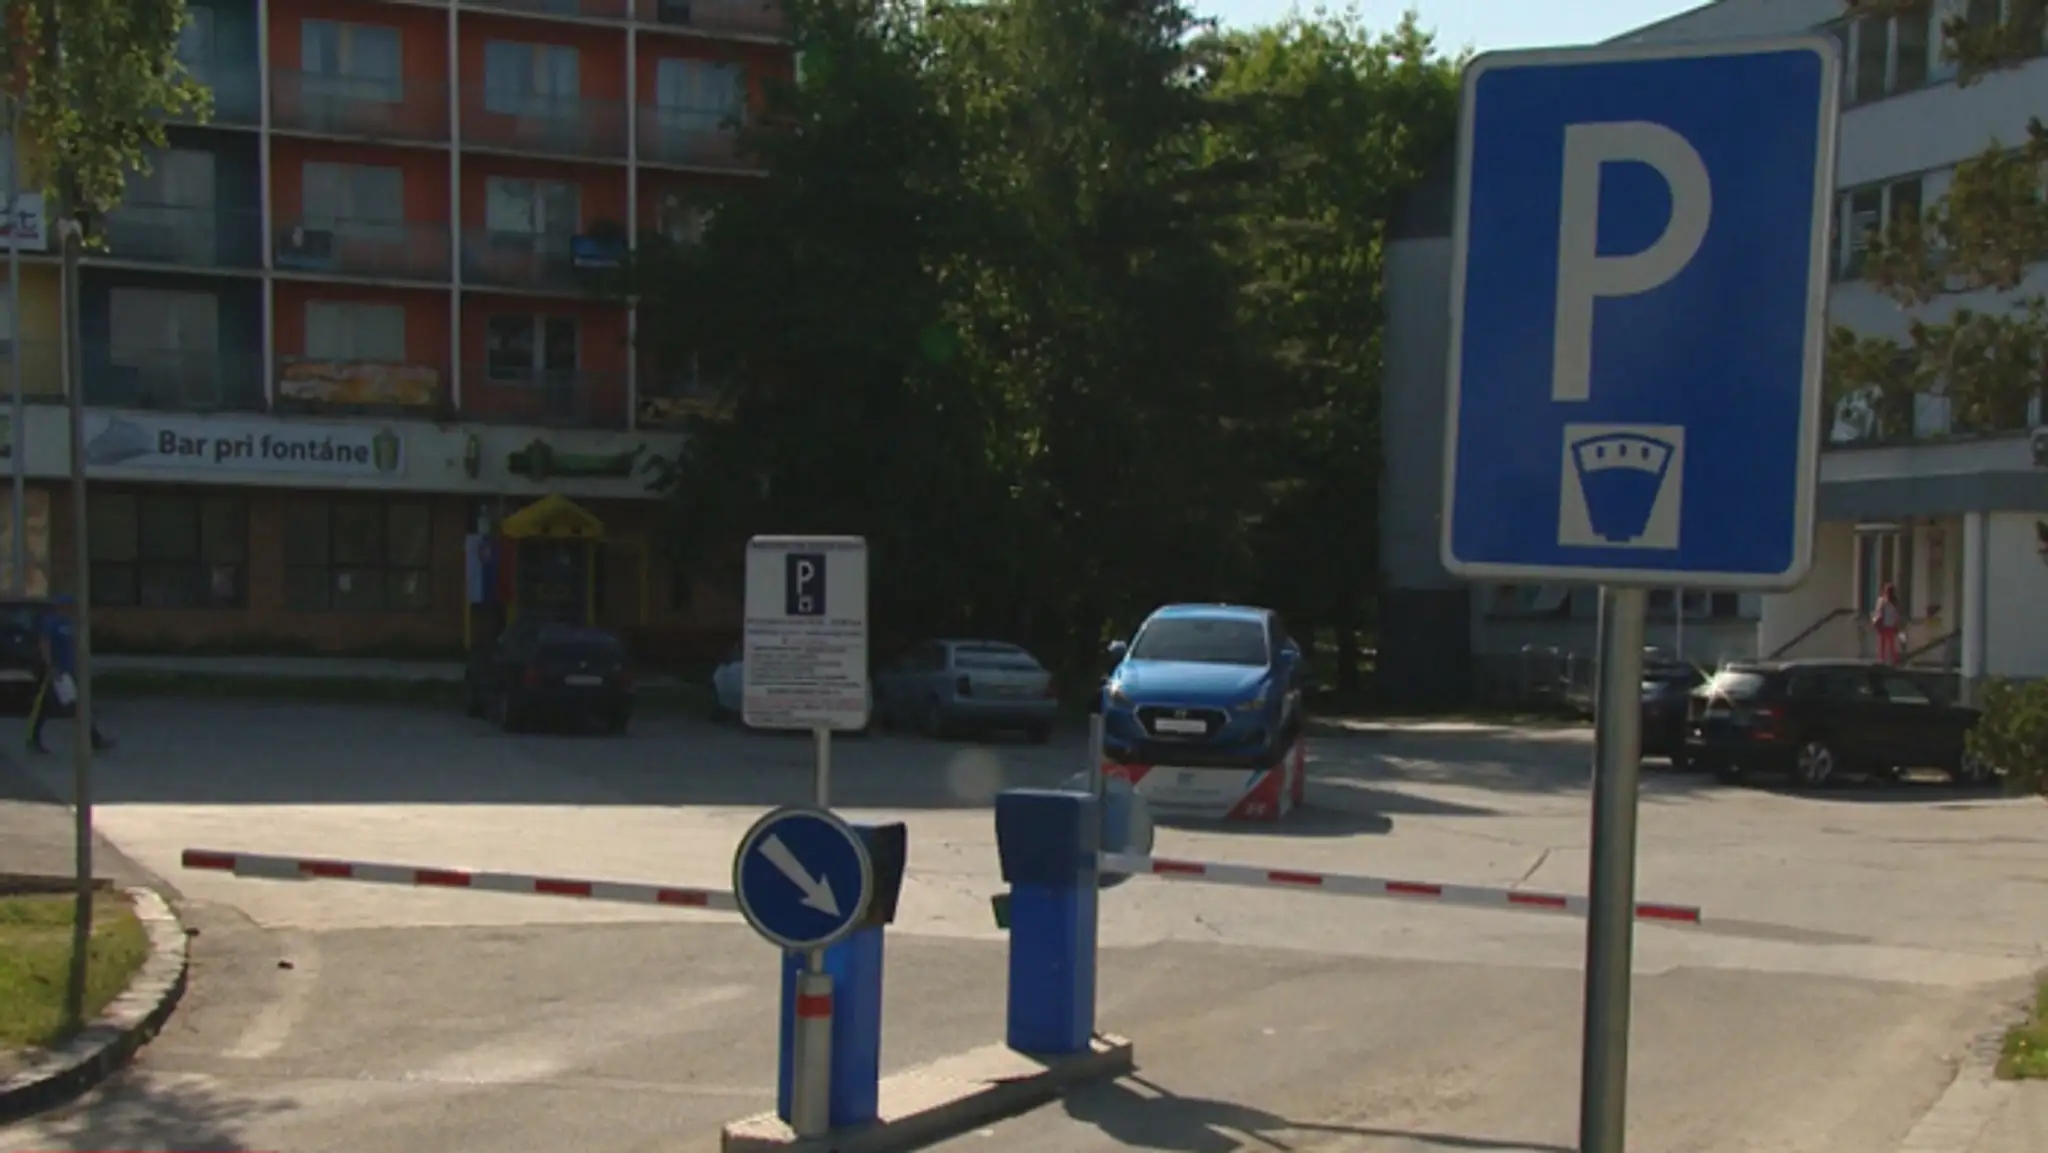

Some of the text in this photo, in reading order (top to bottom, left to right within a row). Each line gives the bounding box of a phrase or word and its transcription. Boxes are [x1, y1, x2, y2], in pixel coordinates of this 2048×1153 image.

[1552, 121, 1712, 401] P
[158, 429, 369, 464] Bar pri fontáne
[796, 559, 815, 595] P
